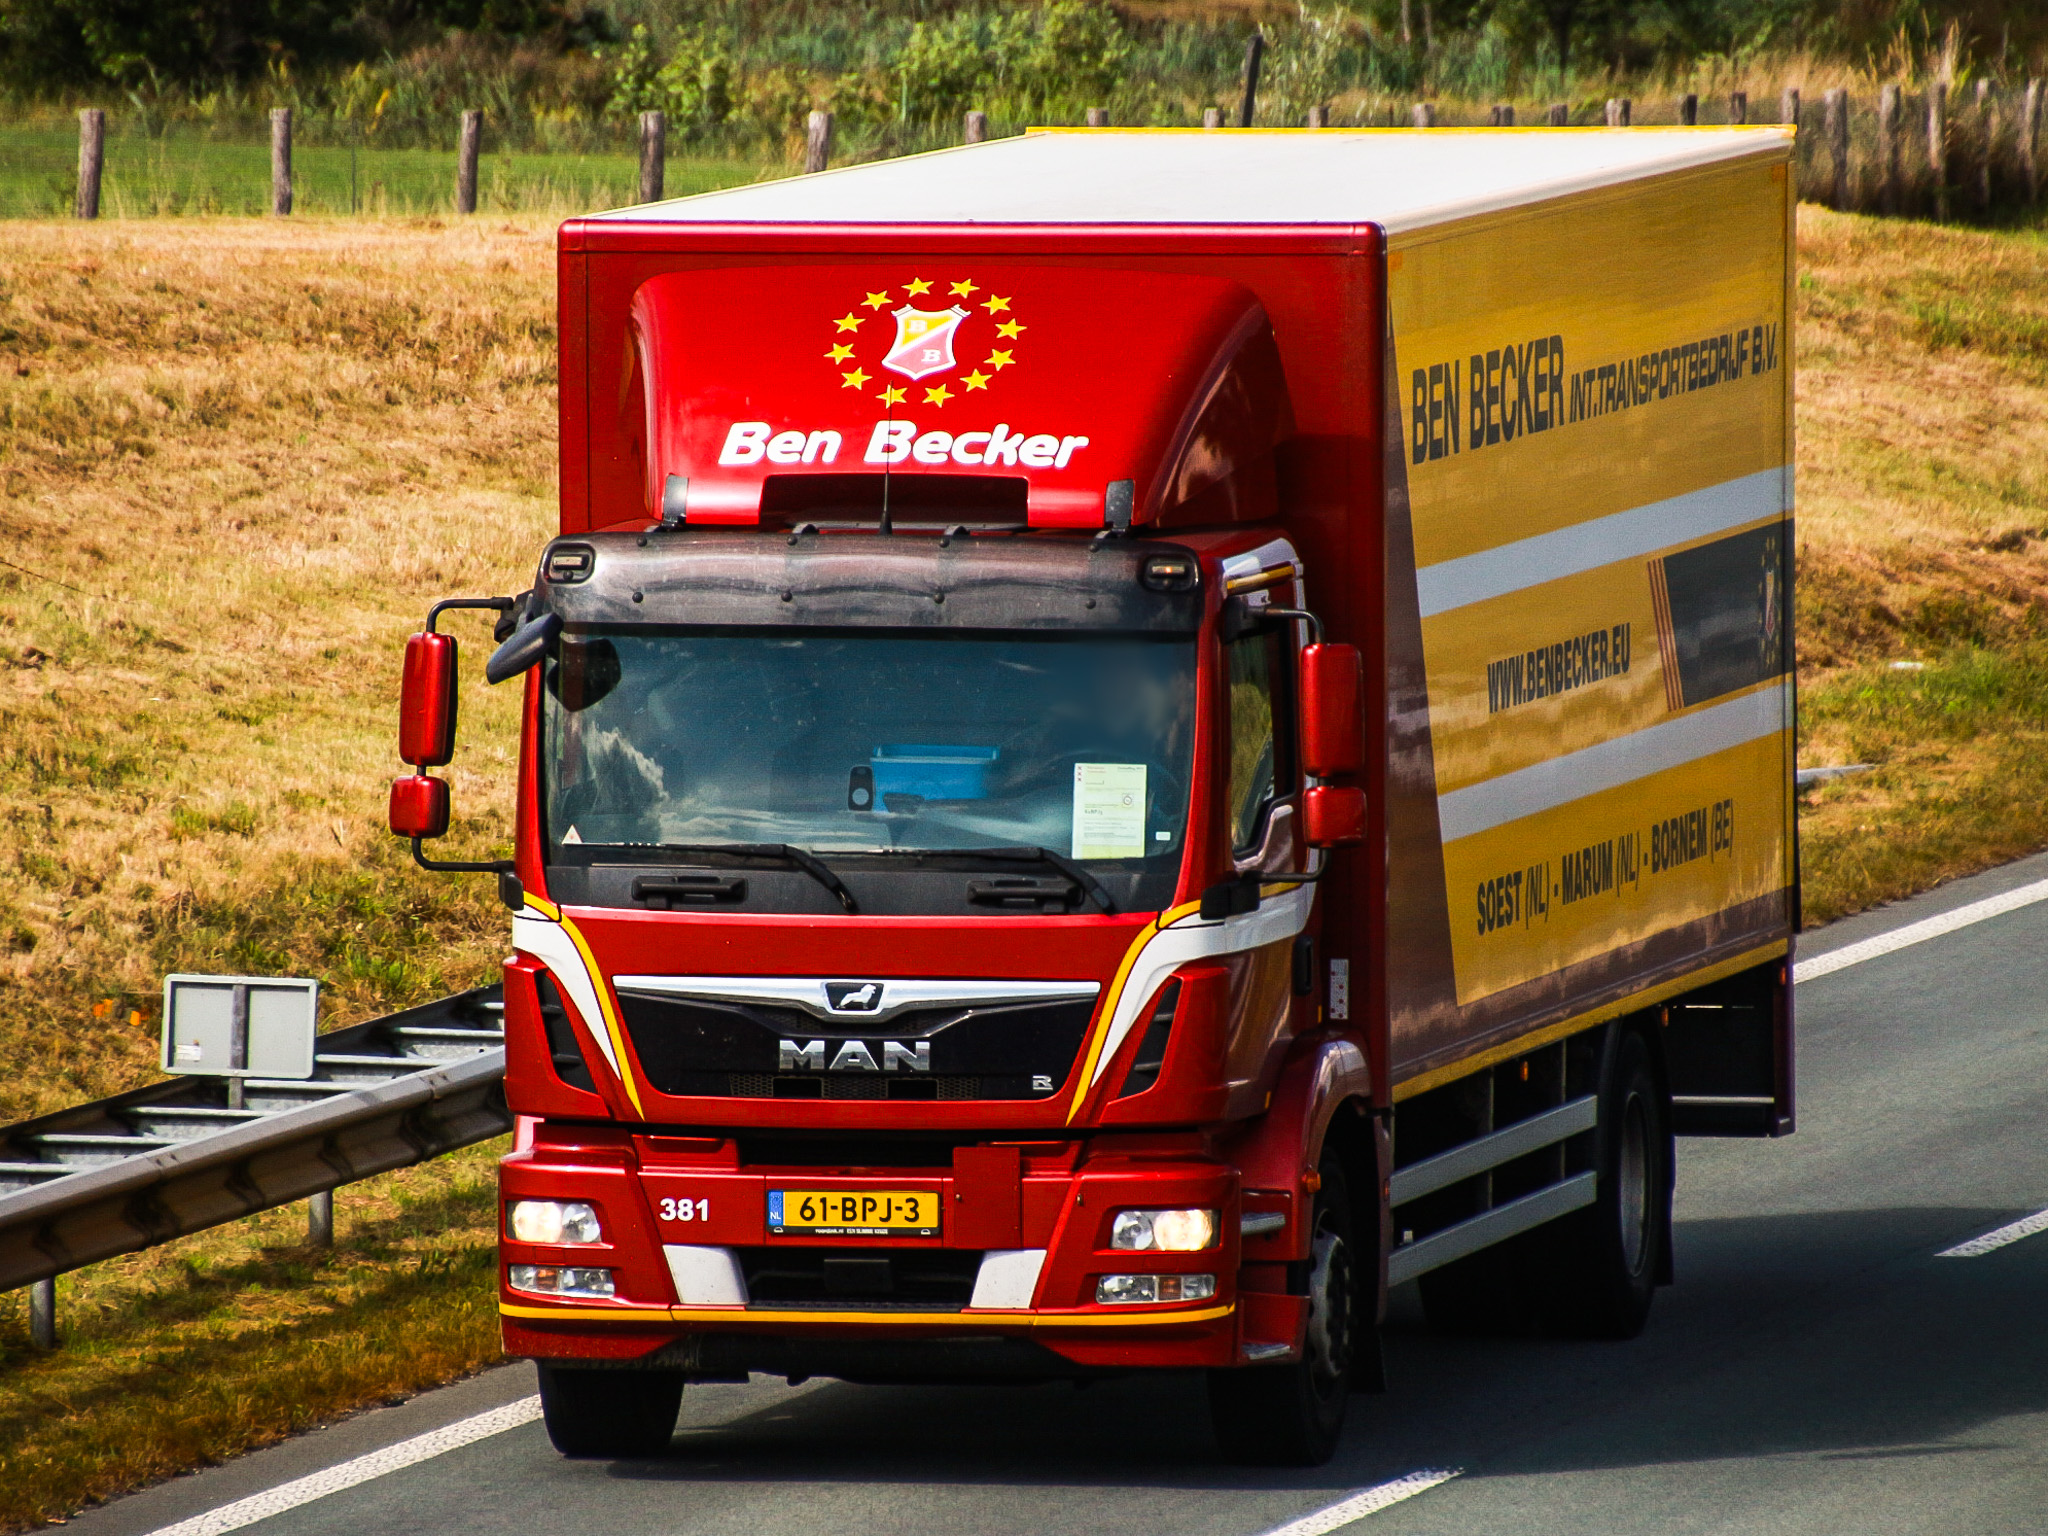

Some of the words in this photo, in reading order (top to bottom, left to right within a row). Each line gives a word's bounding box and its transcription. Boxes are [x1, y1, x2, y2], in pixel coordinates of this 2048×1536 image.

[921, 349, 941, 362] B
[1412, 360, 1461, 465] BEN
[1469, 334, 1565, 450] BECKER
[1751, 322, 1778, 375] B.V.
[718, 420, 843, 467] Ben
[862, 419, 1090, 469] Becker
[1487, 622, 1631, 713] WWW.BENBECKER.EU
[1477, 870, 1522, 936] SOEST
[1525, 861, 1550, 930] (NL)
[1562, 839, 1613, 905] MARUM
[1617, 830, 1640, 898] (NL)
[1651, 807, 1707, 875] BORNEM
[1710, 798, 1734, 864] (BE)
[779, 1039, 931, 1071] MAN
[659, 1198, 709, 1222] 381
[770, 1211, 782, 1220] NL
[799, 1197, 920, 1223] 61-BPJ-3
